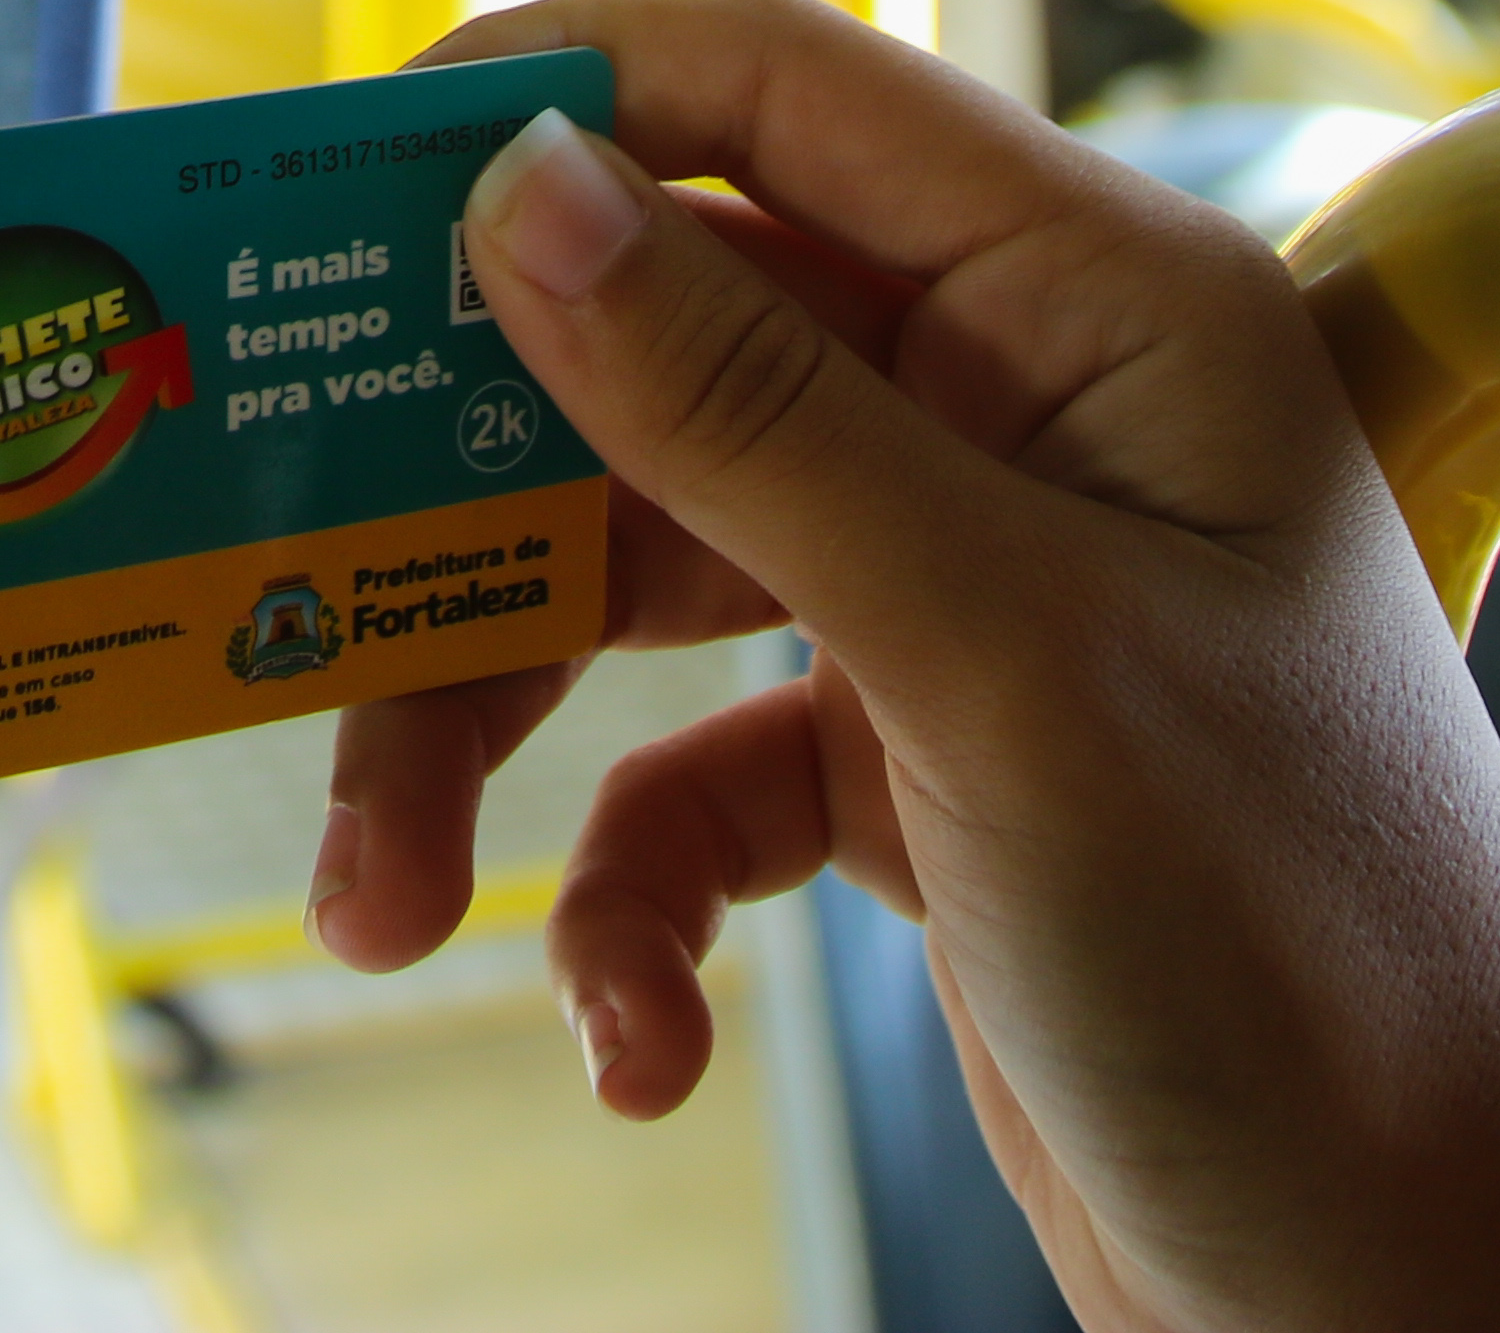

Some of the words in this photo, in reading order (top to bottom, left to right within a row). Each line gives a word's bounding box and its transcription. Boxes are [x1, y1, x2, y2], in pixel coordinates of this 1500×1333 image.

[178, 159, 243, 194] STD
[269, 115, 537, 182] 361317153435187
[226, 247, 260, 300] É
[271, 238, 391, 294] mais
[226, 306, 391, 362] tempo
[226, 380, 312, 432] pra
[323, 348, 455, 406] você.
[469, 398, 528, 452] 2k
[353, 546, 506, 596] Prefeitura
[514, 535, 552, 563] de
[352, 576, 550, 645] Fortaleza
[12, 650, 23, 669] E
[14, 677, 45, 697] em
[49, 666, 96, 689] caso
